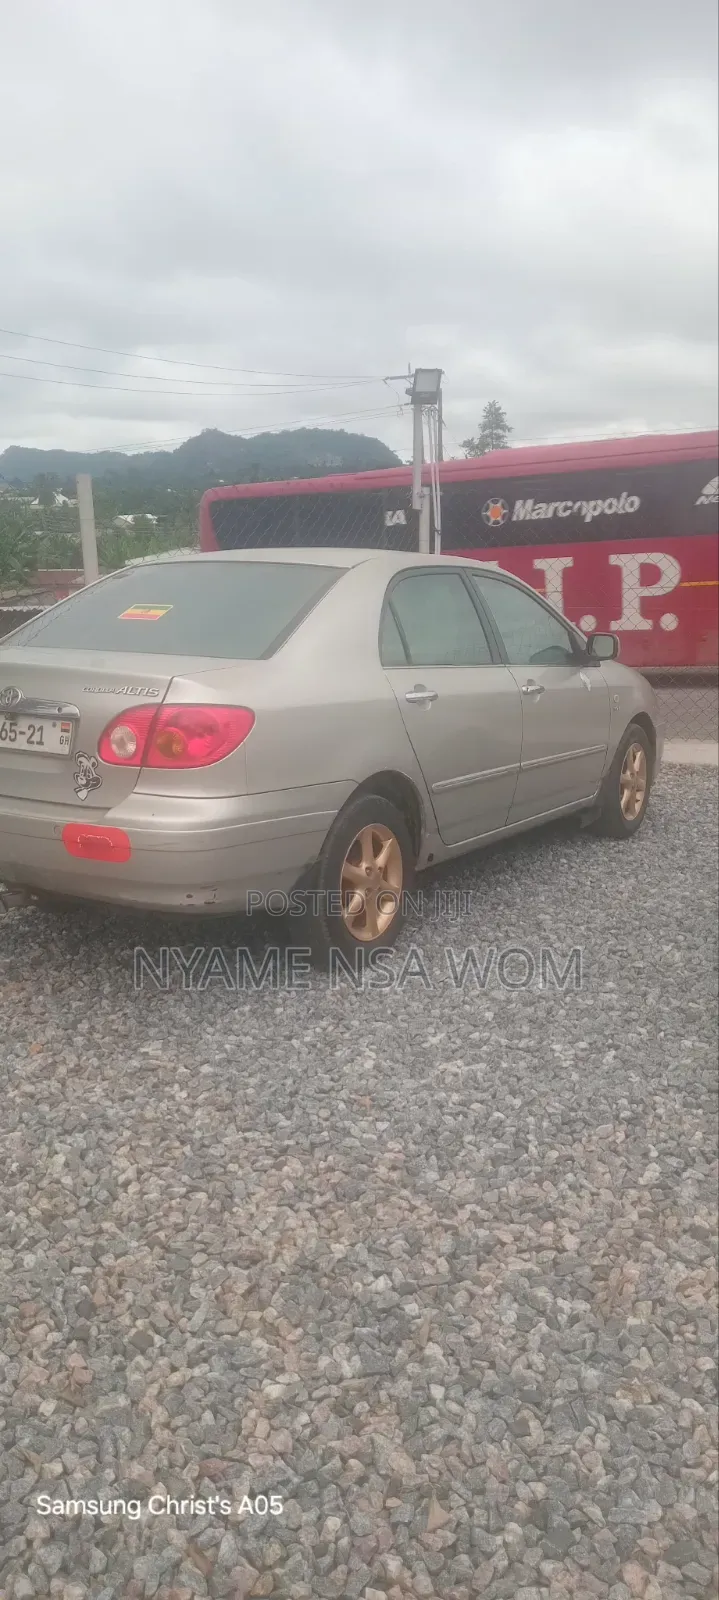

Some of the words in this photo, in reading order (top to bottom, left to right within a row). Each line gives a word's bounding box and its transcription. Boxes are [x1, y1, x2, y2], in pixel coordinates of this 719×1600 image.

[511, 491, 640, 523] Marcopolo
[484, 552, 681, 631] I.P.
[115, 685, 159, 698] ALTIS
[59, 735, 70, 746] GH
